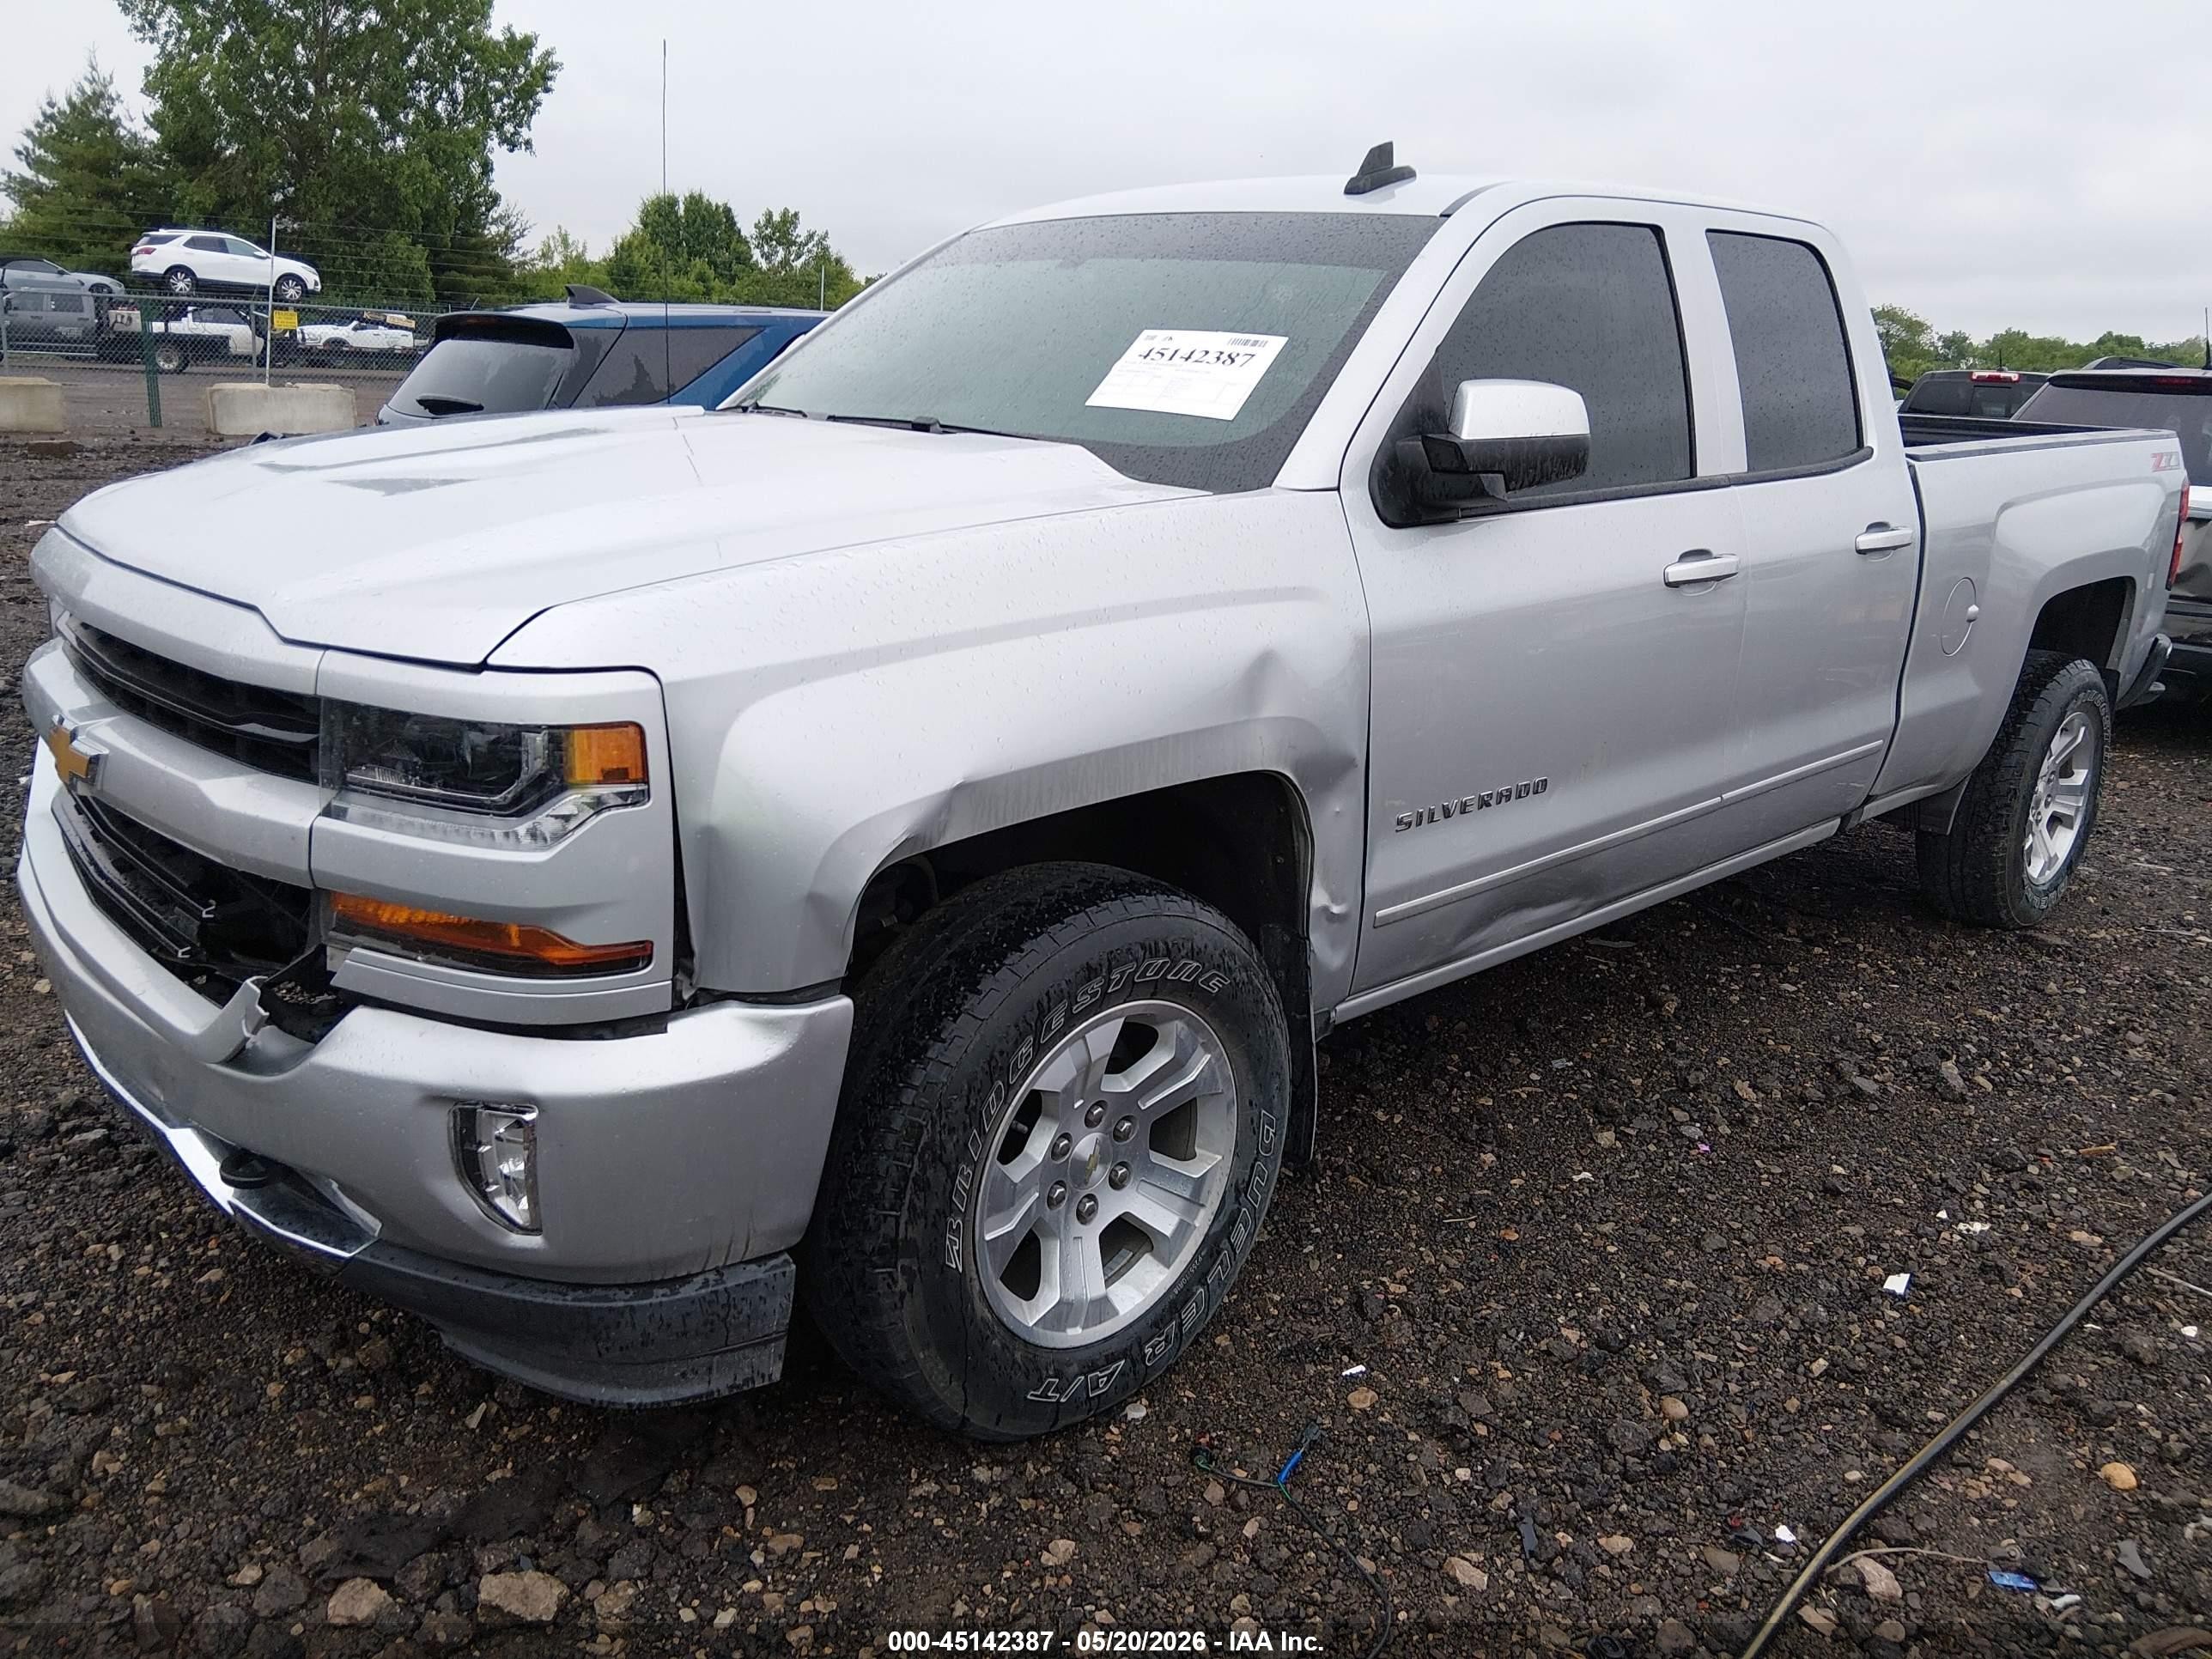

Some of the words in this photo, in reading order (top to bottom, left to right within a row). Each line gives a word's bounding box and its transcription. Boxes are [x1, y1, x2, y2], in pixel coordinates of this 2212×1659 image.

[1138, 347, 1256, 368] 45142387
[1395, 776, 1548, 833] SILVERADO
[945, 957, 1231, 1273] BRIDGESTONE
[1145, 1109, 1277, 1366] DUELER
[1026, 1358, 1126, 1403] A/T
